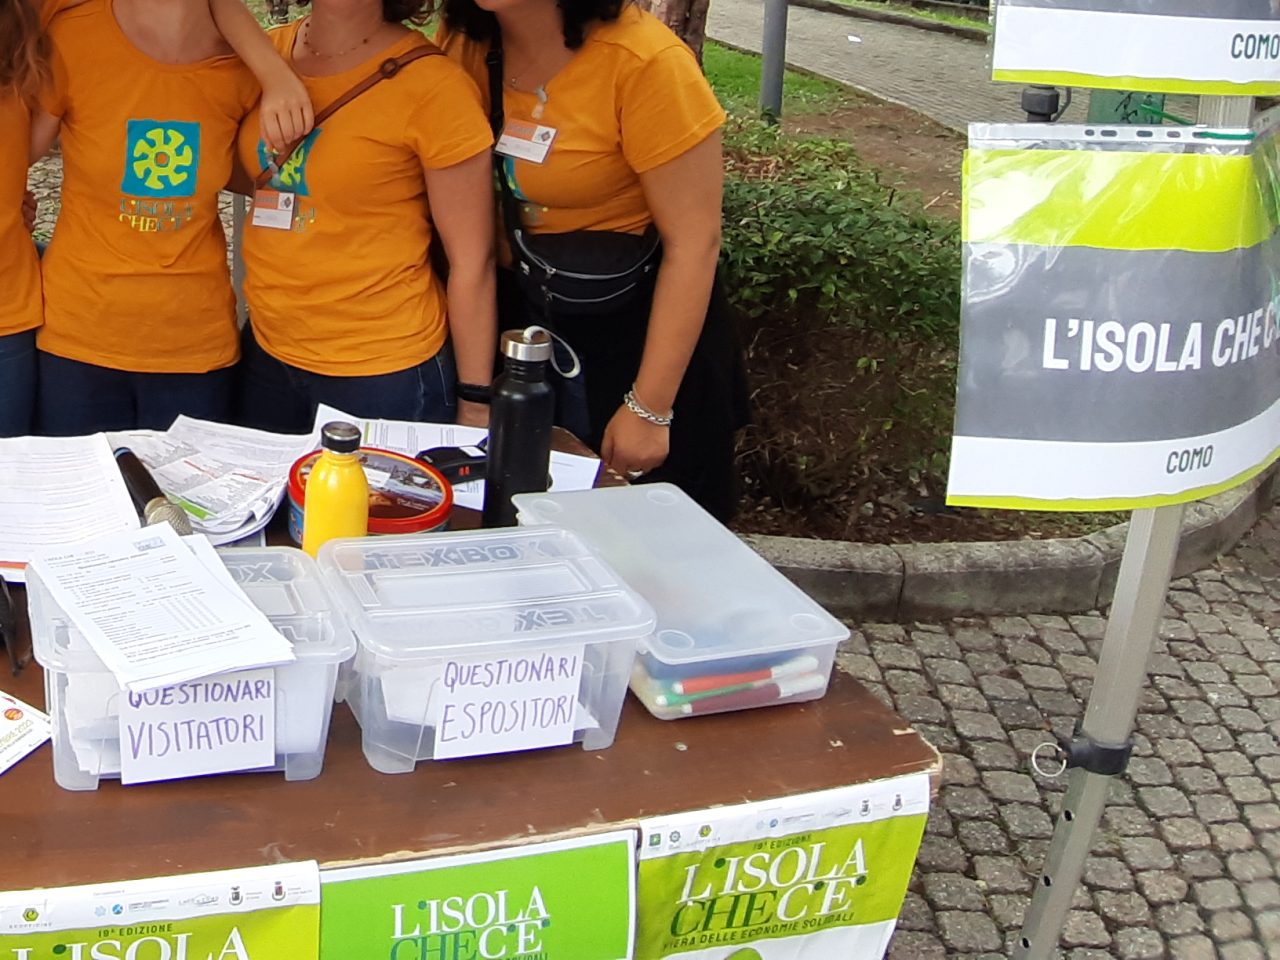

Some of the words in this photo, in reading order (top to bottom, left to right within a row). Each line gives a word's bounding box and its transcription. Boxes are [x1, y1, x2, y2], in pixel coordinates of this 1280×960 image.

[118, 212, 158, 232] CHE
[1042, 318, 1202, 372] L'ISOLA
[1211, 308, 1263, 368] CHE
[1166, 444, 1214, 474] COMO
[127, 678, 271, 708] QUESTIONARI
[443, 655, 577, 691] QUESTIONARI
[127, 713, 264, 760] VISITATORI
[440, 695, 575, 742] ESPOSITORI
[676, 837, 869, 904] L'ISOLA
[119, 923, 173, 937] EDIZIONE
[391, 885, 551, 939] L'ISOLA
[670, 890, 778, 938] CHE
[700, 932, 737, 944] DELLE
[740, 923, 799, 941] ECONOMIE
